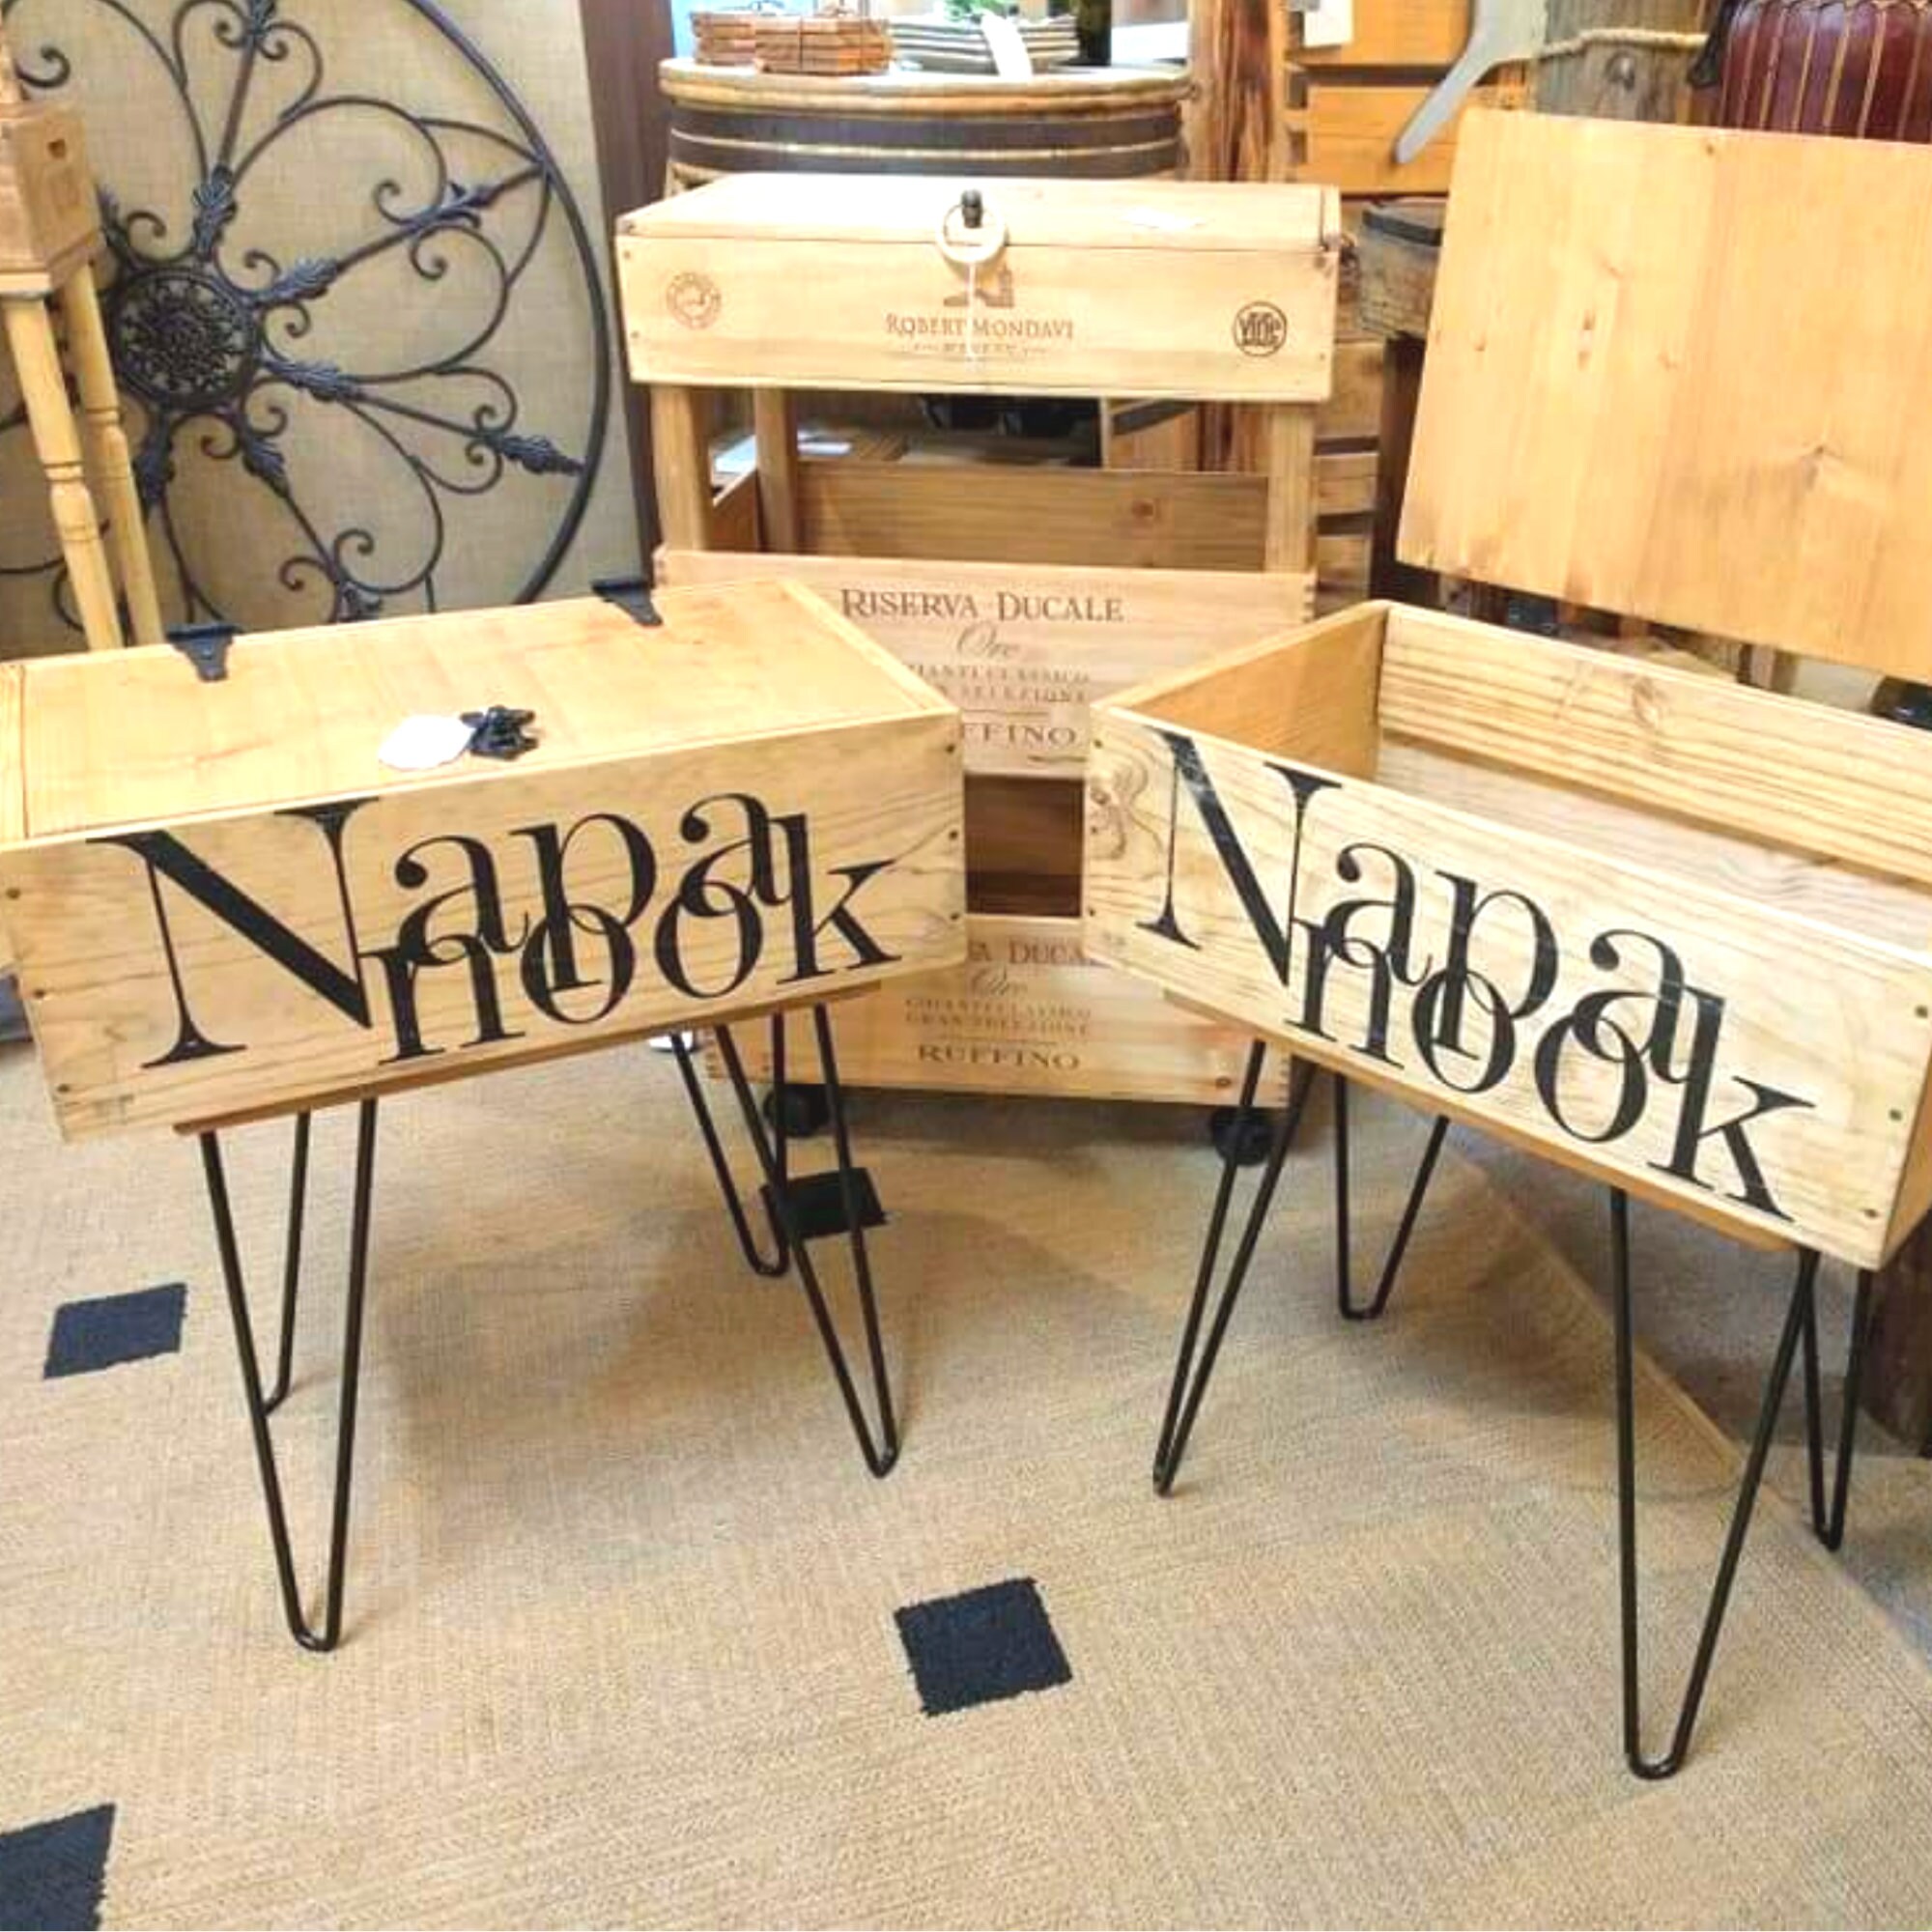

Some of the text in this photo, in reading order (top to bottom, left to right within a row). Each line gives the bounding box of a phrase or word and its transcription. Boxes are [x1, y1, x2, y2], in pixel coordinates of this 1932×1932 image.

[886, 313, 1074, 340] ROBERT MONDAVI
[840, 587, 1125, 622] RISERVA DUCALE
[961, 723, 1077, 746] FFINO
[918, 1044, 1082, 1070] RUFFINO
